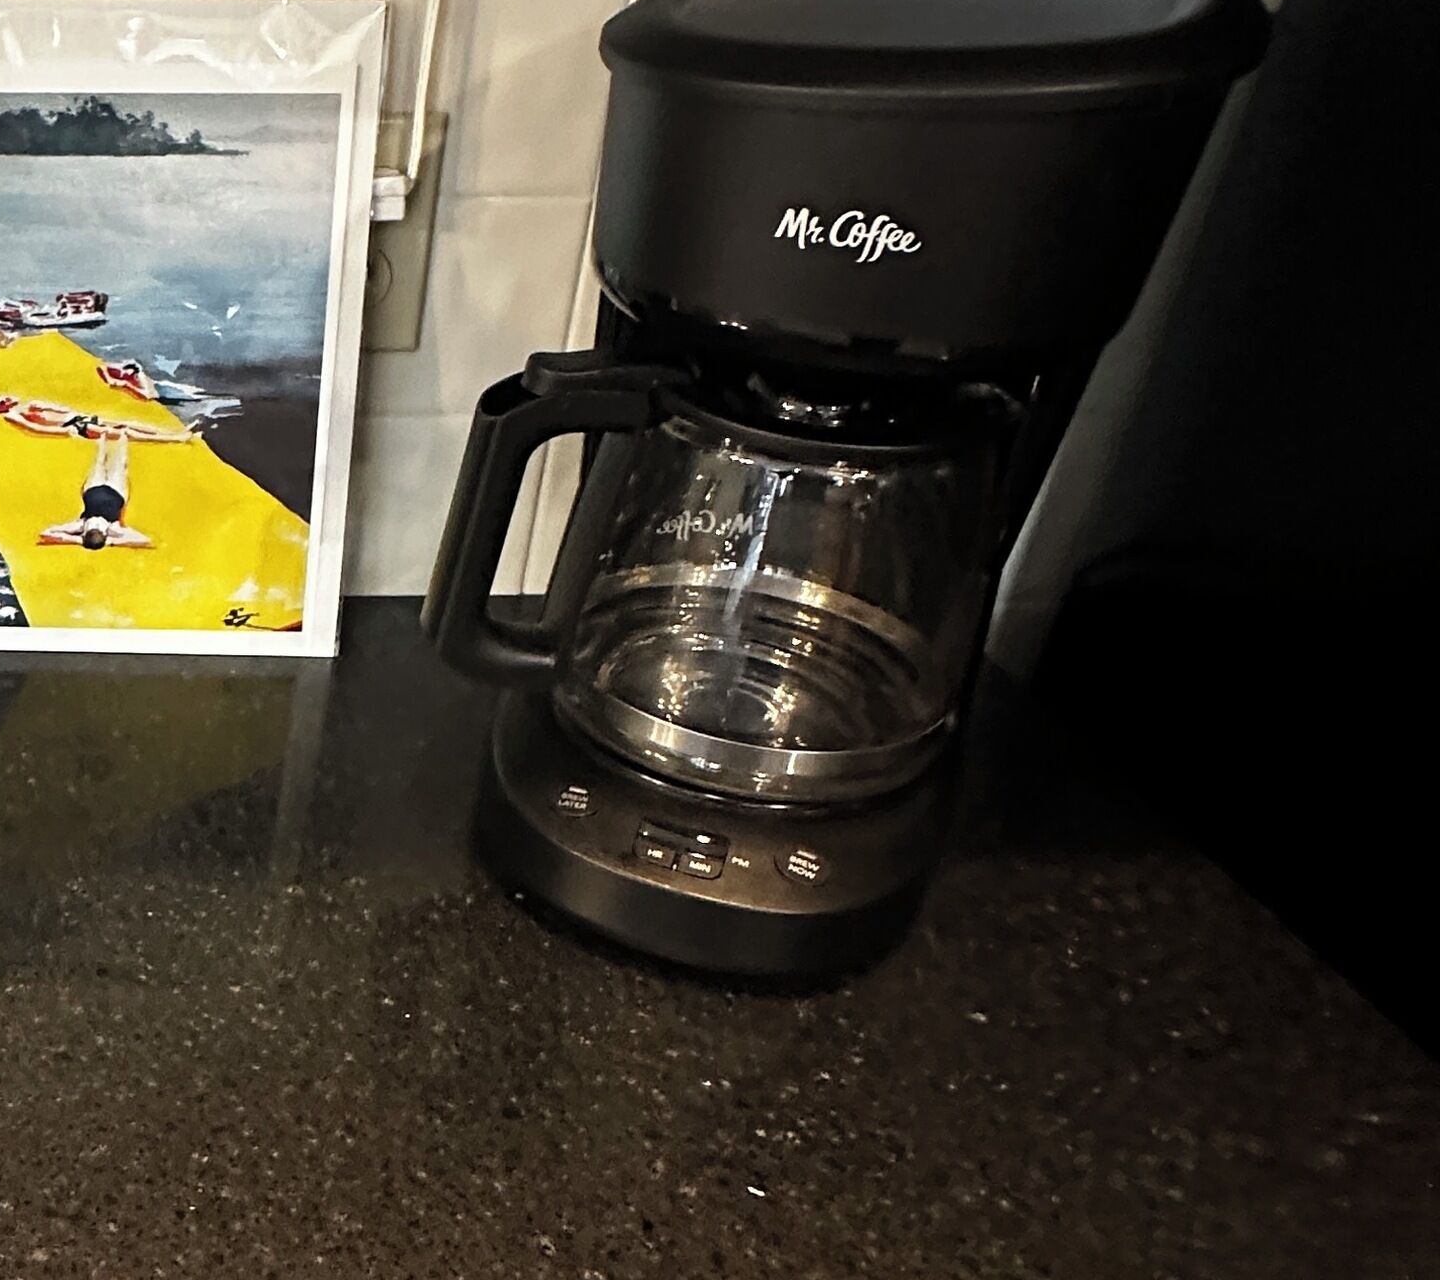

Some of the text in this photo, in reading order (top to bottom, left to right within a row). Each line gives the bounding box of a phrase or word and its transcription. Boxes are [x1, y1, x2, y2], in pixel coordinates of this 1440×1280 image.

[774, 208, 922, 262] Mr. Coffee
[558, 799, 587, 810] LATER
[689, 860, 711, 873] MIN
[731, 856, 750, 868] PM
[789, 855, 820, 871] BREW
[787, 863, 816, 880] NOW
